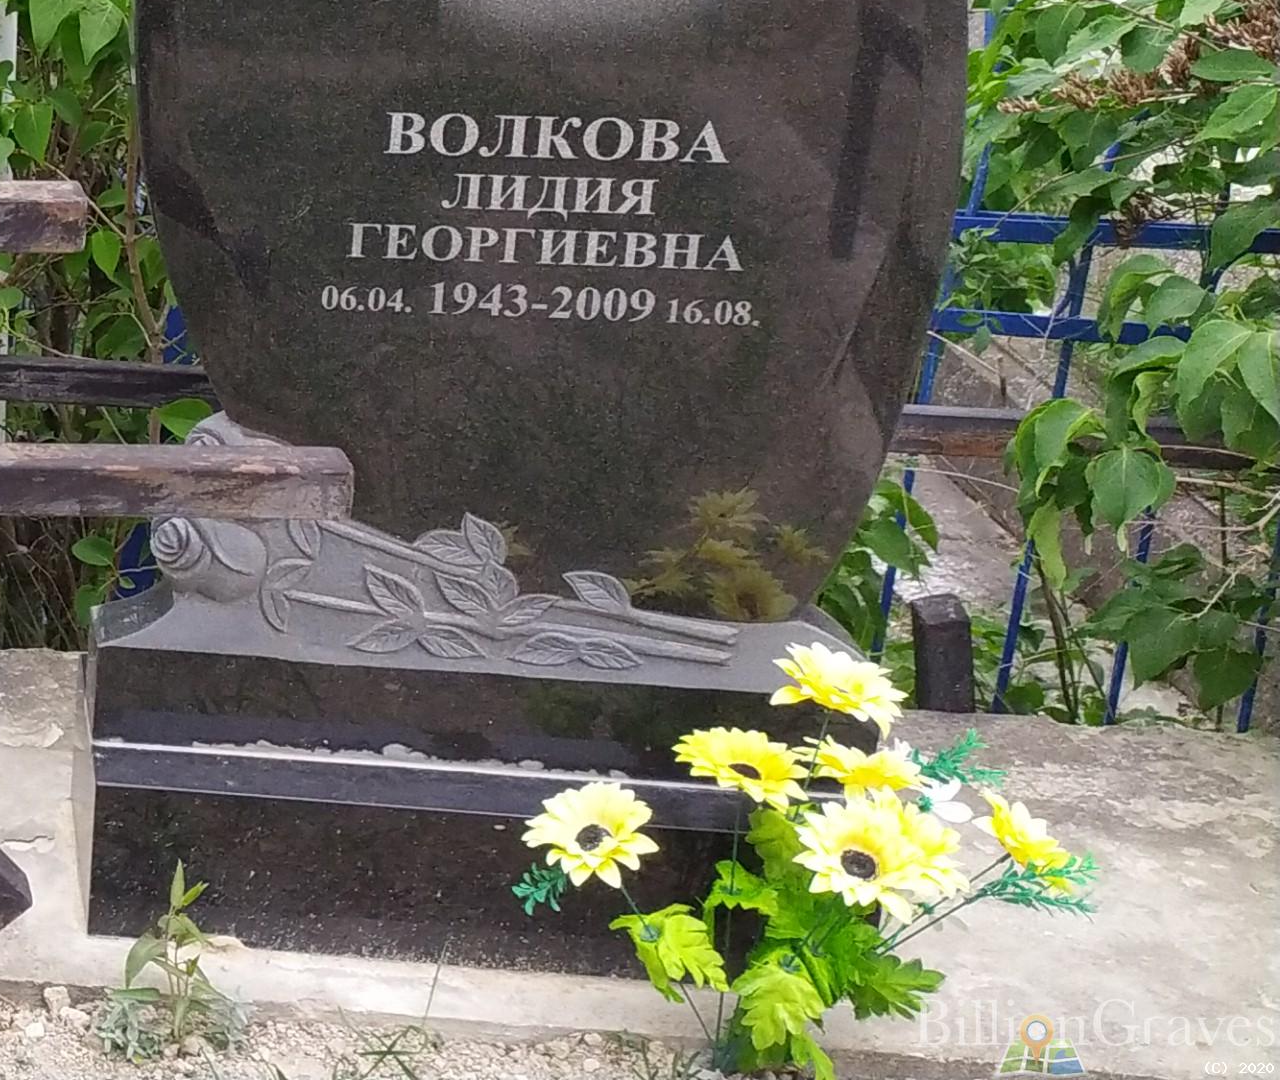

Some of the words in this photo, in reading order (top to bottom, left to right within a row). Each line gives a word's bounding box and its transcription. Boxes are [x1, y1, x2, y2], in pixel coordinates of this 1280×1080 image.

[383, 112, 730, 164] ВОЛКОВА
[440, 173, 660, 221] ЛИДИЯ
[346, 222, 744, 272] ГЕОРГИЕВНА
[321, 285, 413, 314] 06.04.
[429, 281, 656, 322] 1943-2009
[665, 298, 761, 327] 16.08.
